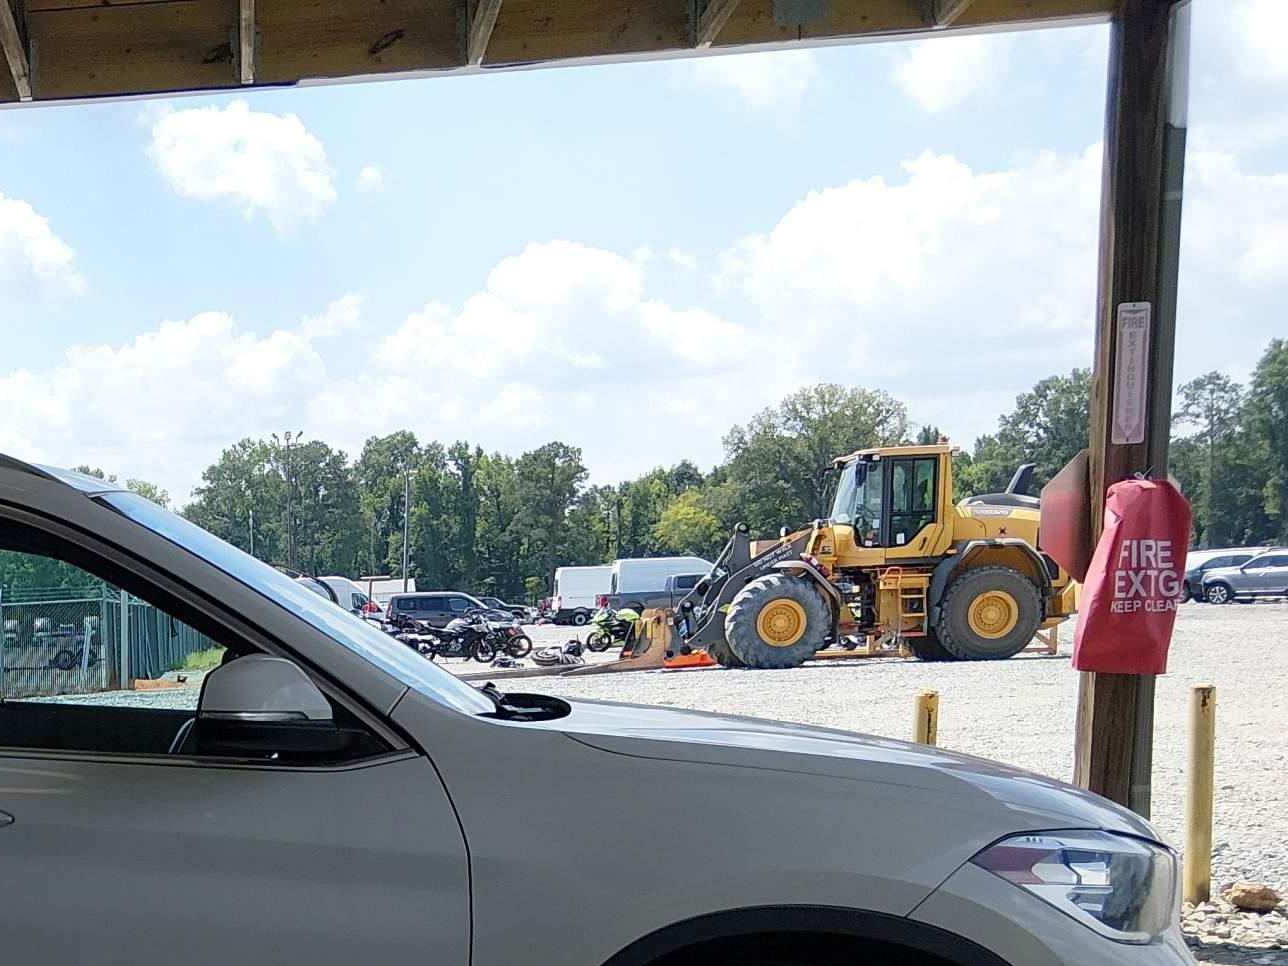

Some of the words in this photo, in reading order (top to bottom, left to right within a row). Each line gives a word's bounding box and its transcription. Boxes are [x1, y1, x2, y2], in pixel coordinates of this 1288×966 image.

[1121, 316, 1145, 329] FIRE
[1118, 539, 1174, 569] FIRE
[1114, 569, 1180, 598] EXTG
[1110, 600, 1142, 613] KEEP
